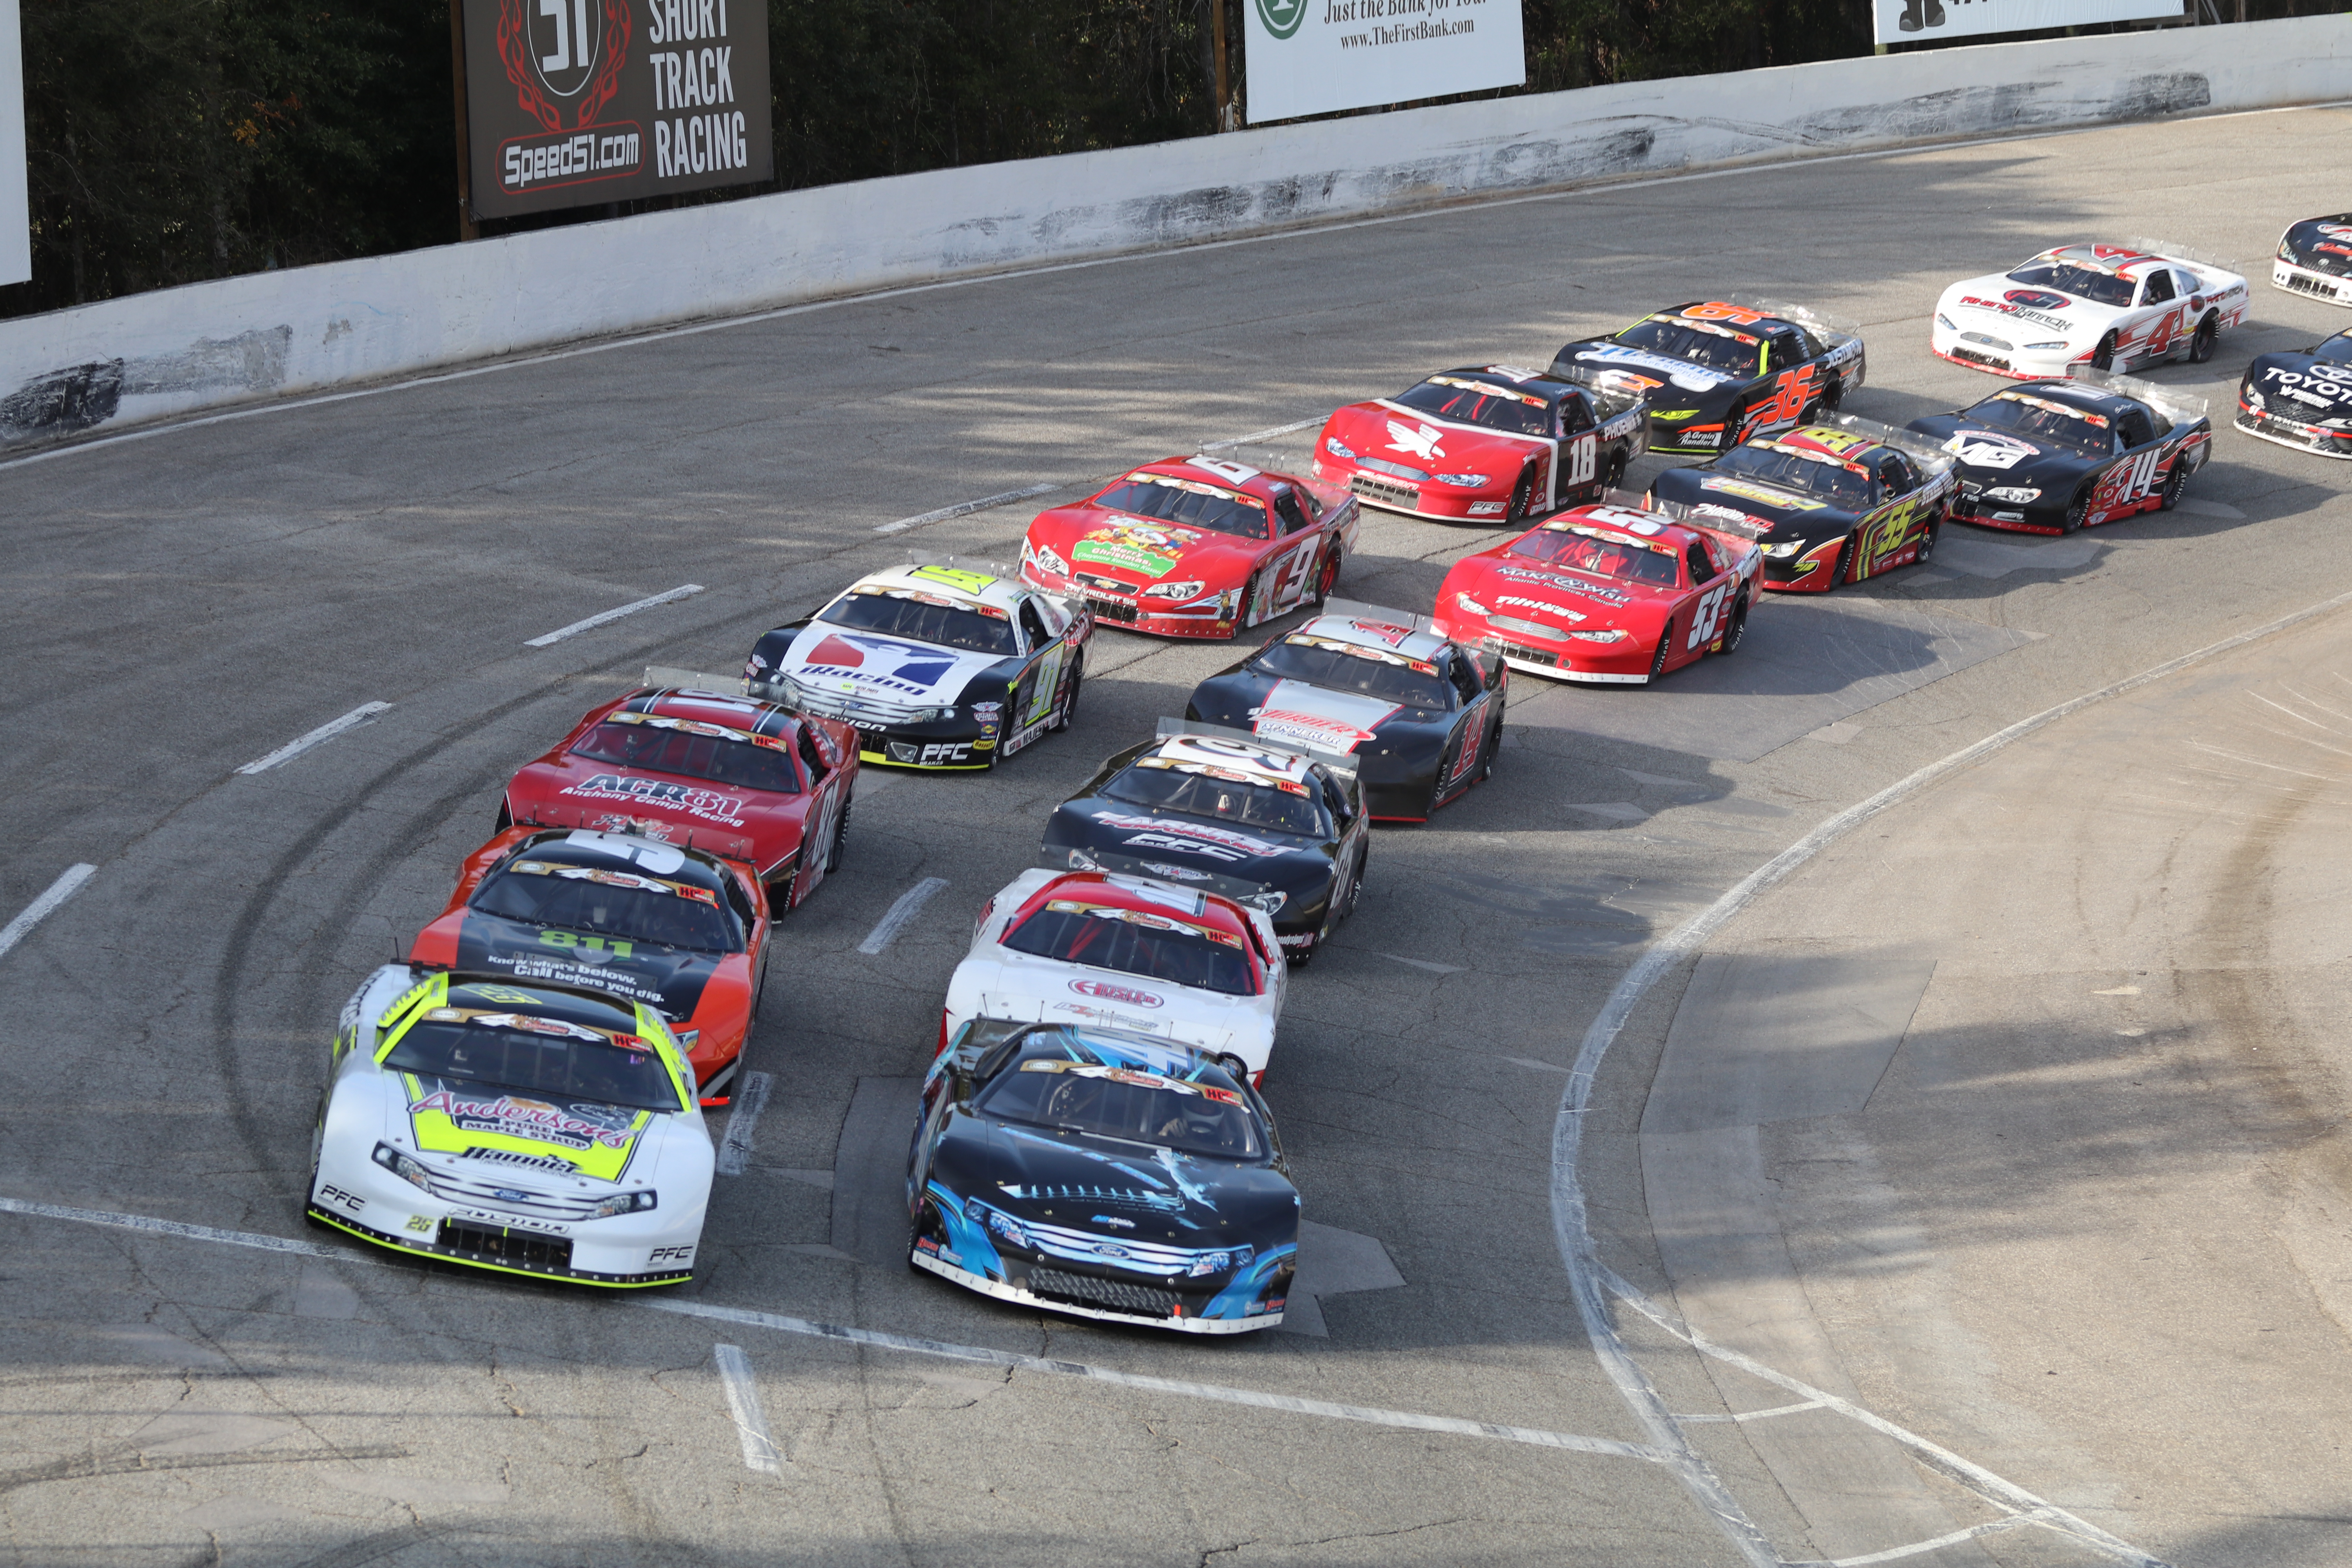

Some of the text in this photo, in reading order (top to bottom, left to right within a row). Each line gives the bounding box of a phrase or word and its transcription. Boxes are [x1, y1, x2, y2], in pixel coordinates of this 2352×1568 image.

[649, 0, 727, 44] SHORT
[1324, 0, 1356, 24] Just
[1360, 0, 1384, 19] the
[1341, 18, 1474, 50] www.TheFirstBank.com
[650, 46, 734, 111] TRACK
[505, 133, 639, 187] Speed51.com
[655, 111, 747, 179] RACING
[2143, 310, 2181, 357] 4
[1761, 363, 1816, 425] 36
[2261, 367, 2352, 408] TOYOT
[1568, 434, 1597, 487] 18
[2121, 447, 2162, 505] 14
[1471, 501, 1507, 512] PFC
[1875, 498, 1918, 558] 55
[1091, 547, 1152, 567] Christmas,
[1110, 546, 1144, 558] Merry
[1279, 532, 1321, 604] 9
[1504, 577, 1624, 609] Atlantic Provinces Canada
[1687, 584, 1726, 651] 53
[796, 665, 929, 695] iRacing
[921, 742, 973, 761] PFC
[558, 785, 745, 828] Anthony Campi Racing
[576, 773, 743, 818] ACR81
[1125, 833, 1248, 861] PFC
[539, 930, 633, 958] 811
[1276, 934, 1304, 946] peedysigns
[488, 955, 637, 986] Know what's below.
[514, 964, 665, 1003] Call before you dig.
[410, 1091, 634, 1147] Anderson's
[465, 1121, 587, 1149] MAPLE SYRUP
[502, 1120, 552, 1134] PURE
[320, 1184, 366, 1211] PFC
[402, 1214, 437, 1234] 26
[447, 1206, 570, 1234] FUSION
[649, 1246, 693, 1262] PFC
[1099, 1245, 1122, 1257] Ford
